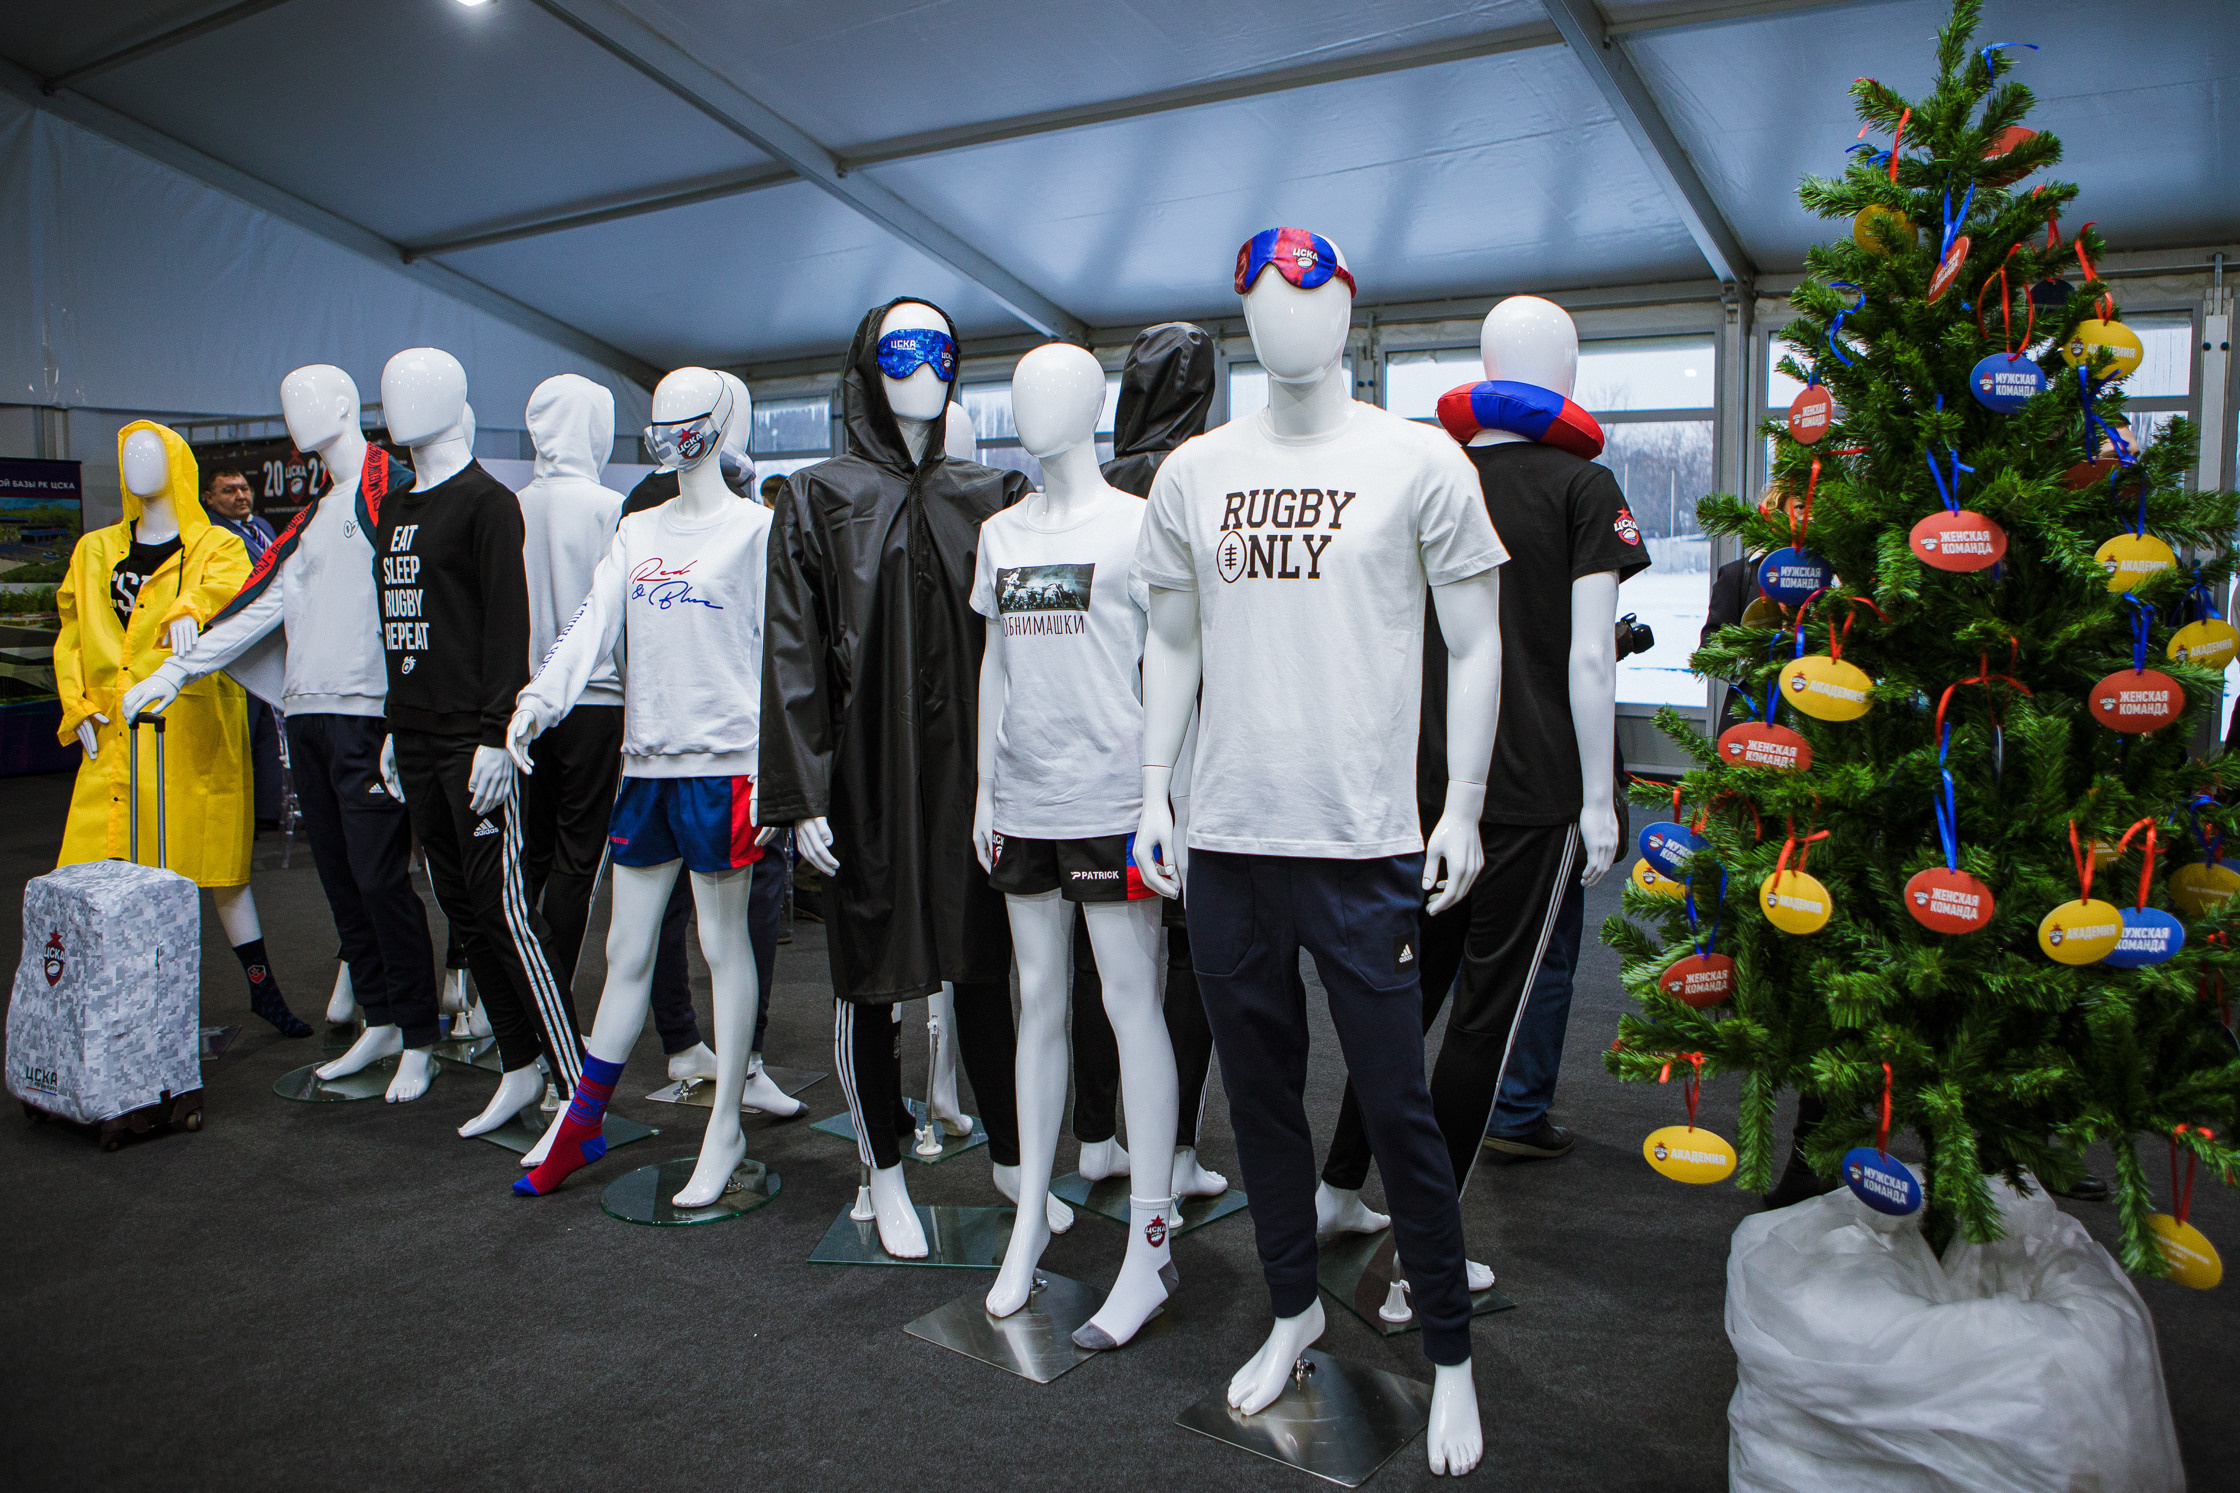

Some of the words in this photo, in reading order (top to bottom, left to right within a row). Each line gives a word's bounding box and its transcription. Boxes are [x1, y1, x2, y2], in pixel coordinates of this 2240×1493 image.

[1293, 248, 1318, 262] ЦСКА
[890, 340, 916, 348] ЦСКА
[1995, 373, 2036, 385] МУЖСКАЯ
[1995, 385, 2036, 398] КОМАНДА
[676, 433, 703, 455] ЦСКА
[263, 460, 284, 497] 20
[285, 465, 307, 478] ЦСКА
[13, 480, 36, 488] БАЗЫ
[51, 482, 76, 490] ЦСКА
[1220, 489, 1356, 531] RUGBY
[1614, 520, 1639, 532] ЦСКА
[391, 525, 418, 551] EAT
[1940, 531, 1990, 542] ЖЕНСКАЯ
[1217, 531, 1332, 583] ONLY
[1941, 542, 1993, 555] КОМАНДА
[383, 556, 421, 584] SLEEP
[629, 557, 698, 584] Red
[1780, 566, 1821, 577] МУЖСКАЯ
[1780, 577, 1819, 590] КОМАНДА
[384, 589, 423, 617] RUGBY
[632, 584, 645, 600] &
[649, 580, 724, 610] Blue
[1003, 614, 1085, 637] ОБНИМАШКИ
[385, 622, 430, 650] REPEAT
[2190, 638, 2233, 657] АКАДЕМИЯ
[2119, 691, 2169, 702] ЖЕНСКАЯ
[2119, 702, 2169, 716] КОМАНДА
[1747, 739, 1797, 758] ЖЕНСКАЯ
[1081, 870, 1119, 880] PATRICK
[1931, 887, 1980, 907] ЖЕНСКАЯ
[1930, 900, 1979, 920] КОМАНДА
[2066, 924, 2117, 940] АКАДЕМИЯ
[45, 946, 65, 962] ЦСКА
[1686, 969, 1729, 984] ЖЕНСКАЯ
[1685, 980, 1728, 995] КОМАНДА
[26, 1066, 57, 1087] ЦСКА
[1671, 1148, 1727, 1166] АКАДЕМИЯ
[1864, 1166, 1908, 1193] МУЖСКАЯ
[1864, 1178, 1907, 1205] КОМАНДА
